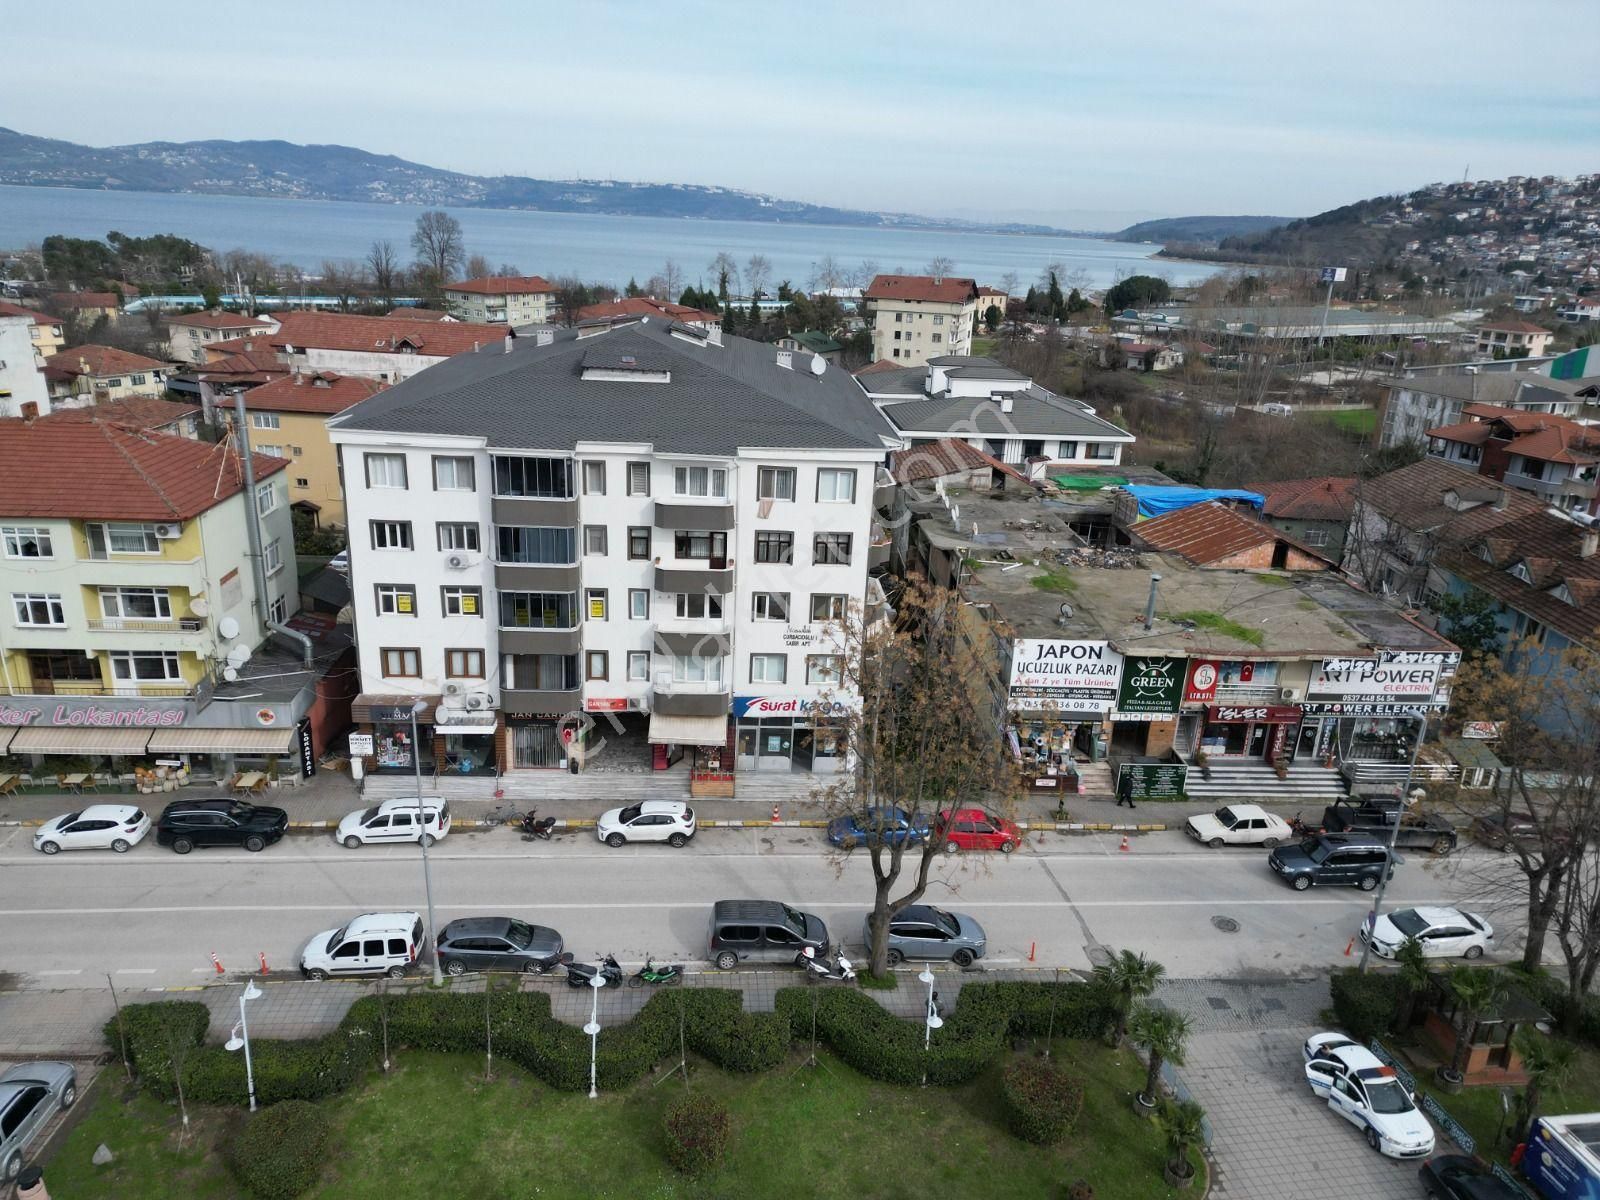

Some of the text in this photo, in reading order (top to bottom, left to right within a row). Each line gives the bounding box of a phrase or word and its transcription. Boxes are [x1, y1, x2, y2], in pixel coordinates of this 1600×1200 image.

[1036, 644, 1104, 660] JAPON
[1017, 661, 1118, 676] UCUZLUK PAZARI
[1064, 678, 1081, 686] Tüm
[1130, 676, 1175, 688] GREEN
[1360, 669, 1435, 684] POWER
[1383, 683, 1431, 693] ELEKTRİK
[53, 704, 186, 725] Lokantası
[1324, 704, 1373, 713] POWER
